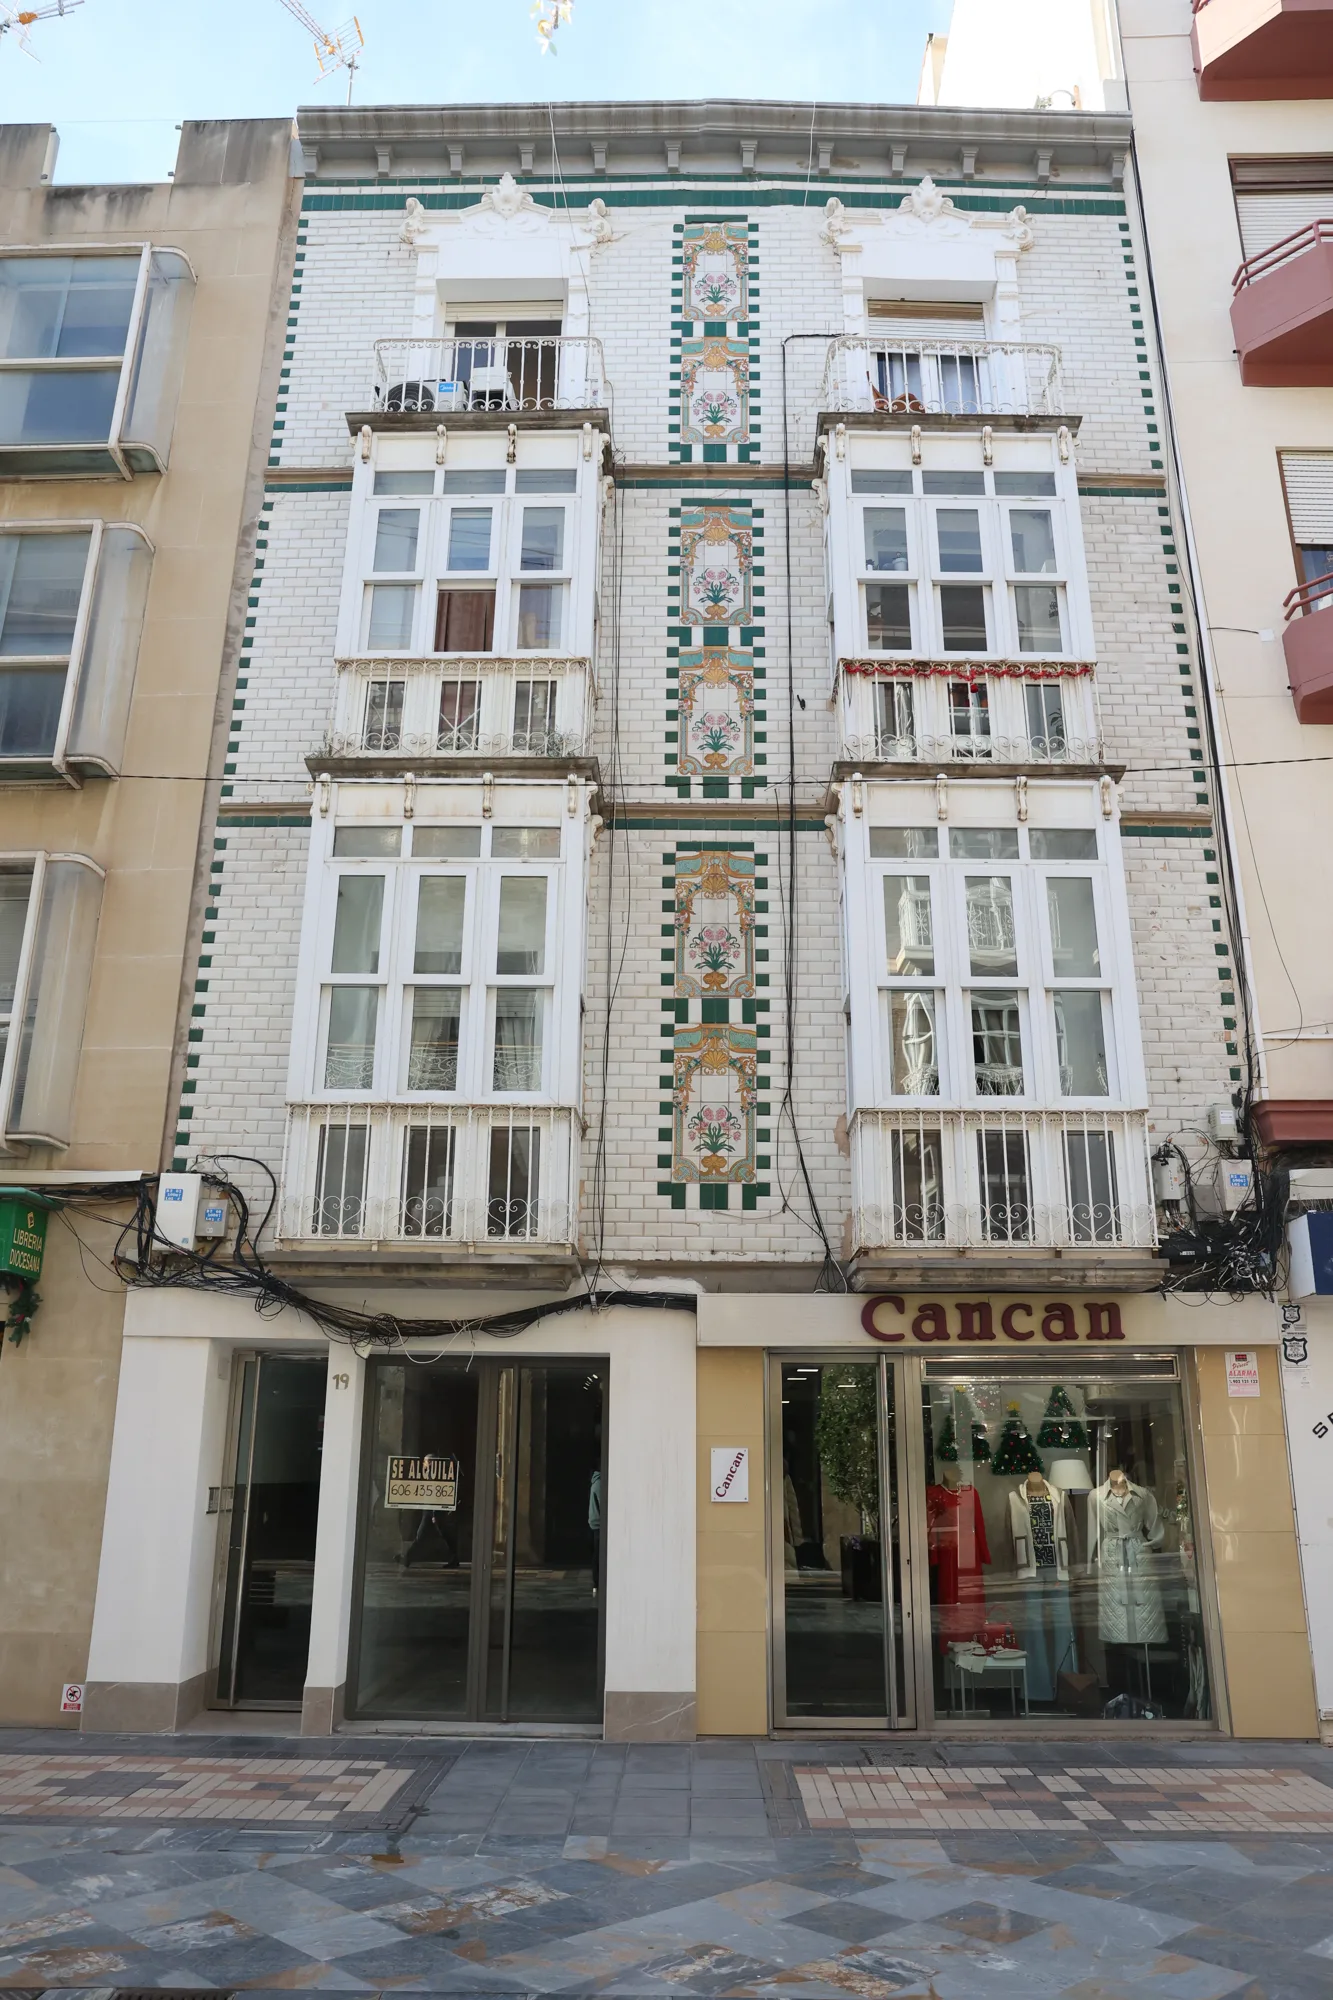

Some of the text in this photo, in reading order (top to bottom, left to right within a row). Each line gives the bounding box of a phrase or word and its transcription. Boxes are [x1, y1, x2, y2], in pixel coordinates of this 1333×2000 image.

[13, 1228, 43, 1252] LIBRERIA
[9, 1249, 41, 1273] DIOCESANA
[861, 1295, 1126, 1342] Cancan
[332, 1373, 350, 1390] 19
[392, 1459, 455, 1480] SE ALQUILA
[715, 1452, 745, 1498] Cancan
[391, 1484, 454, 1498] 606 135 862
